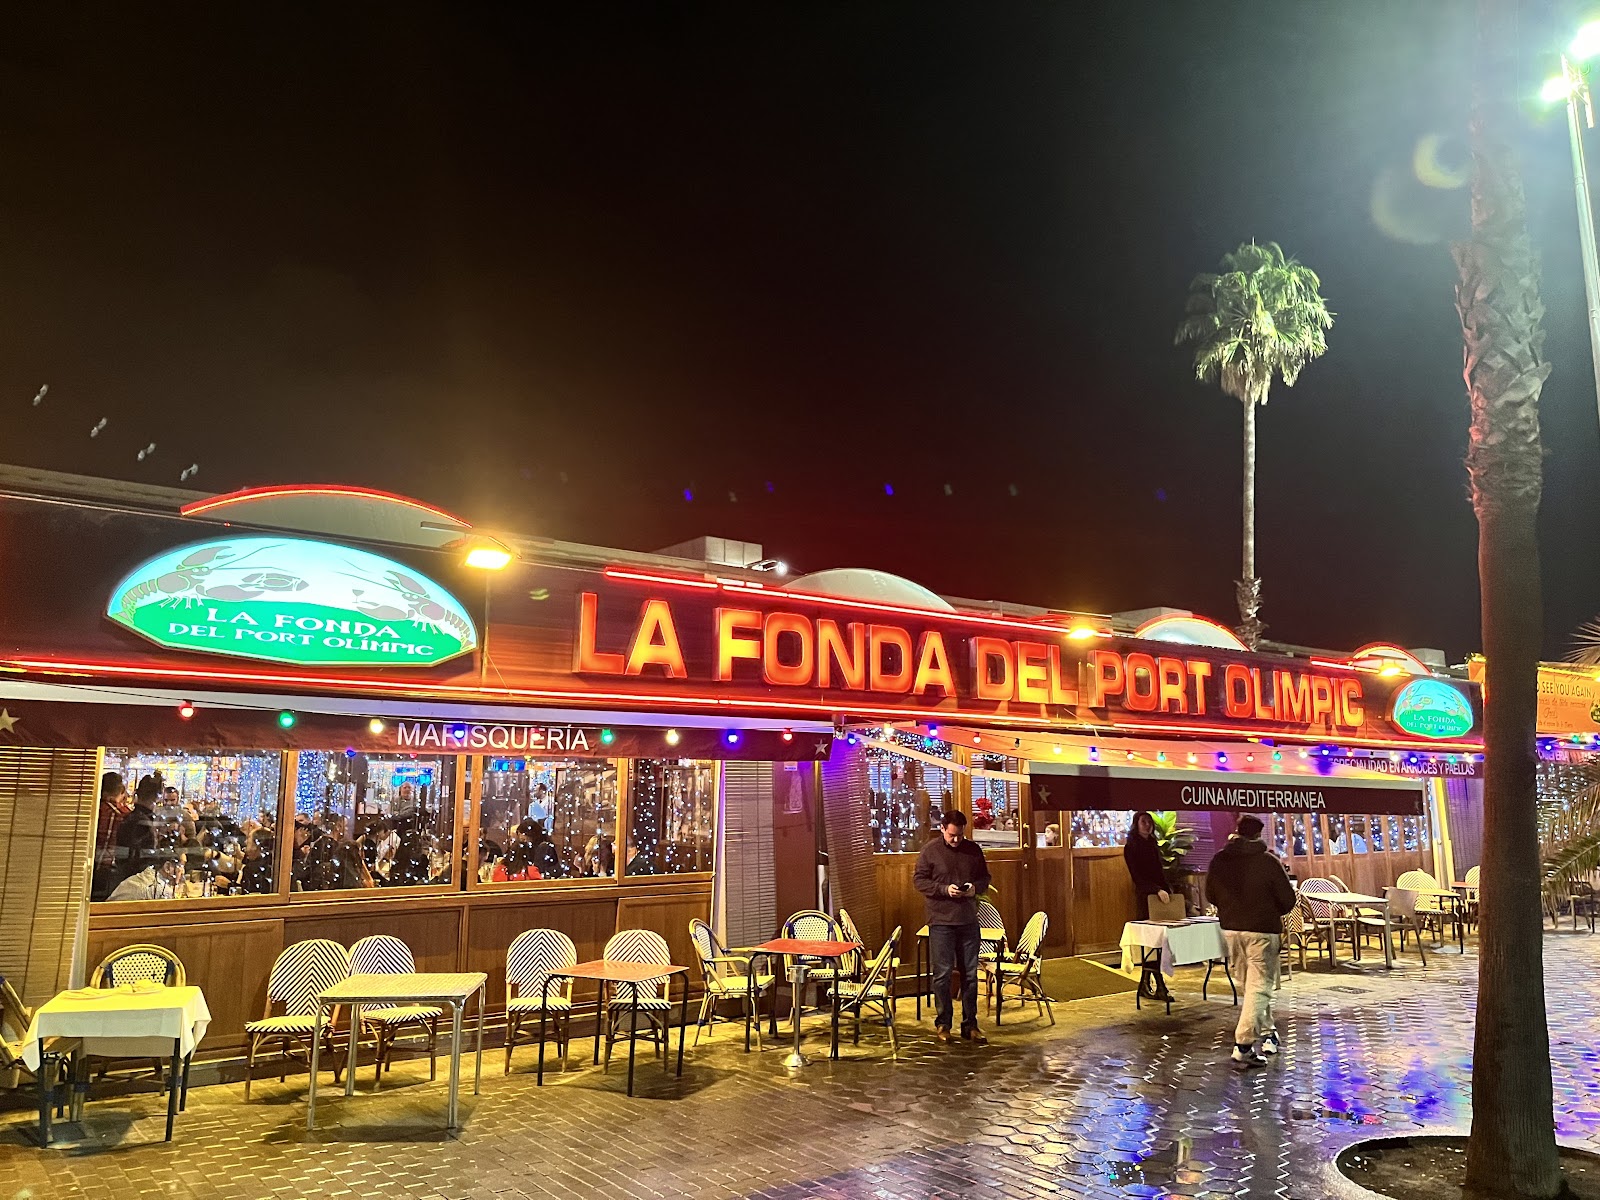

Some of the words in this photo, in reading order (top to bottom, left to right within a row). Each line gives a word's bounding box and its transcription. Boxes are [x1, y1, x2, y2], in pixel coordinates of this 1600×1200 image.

[168, 622, 226, 638] DEL
[234, 628, 315, 646] PORT
[206, 607, 260, 626] LA
[274, 613, 401, 639] FONDA
[573, 591, 688, 679] LA
[713, 606, 957, 698] FONDA
[969, 636, 1079, 706] DEL
[1088, 649, 1212, 716] PORT
[1224, 663, 1365, 728] OLIMPIC
[1541, 681, 1554, 694] SEE
[1555, 683, 1570, 696] YOU
[1413, 713, 1425, 721] LA
[397, 722, 590, 751] MARISQUERÍA
[1389, 760, 1400, 773] EN
[1438, 763, 1443, 775] Y
[1445, 763, 1475, 776] PAELLAS
